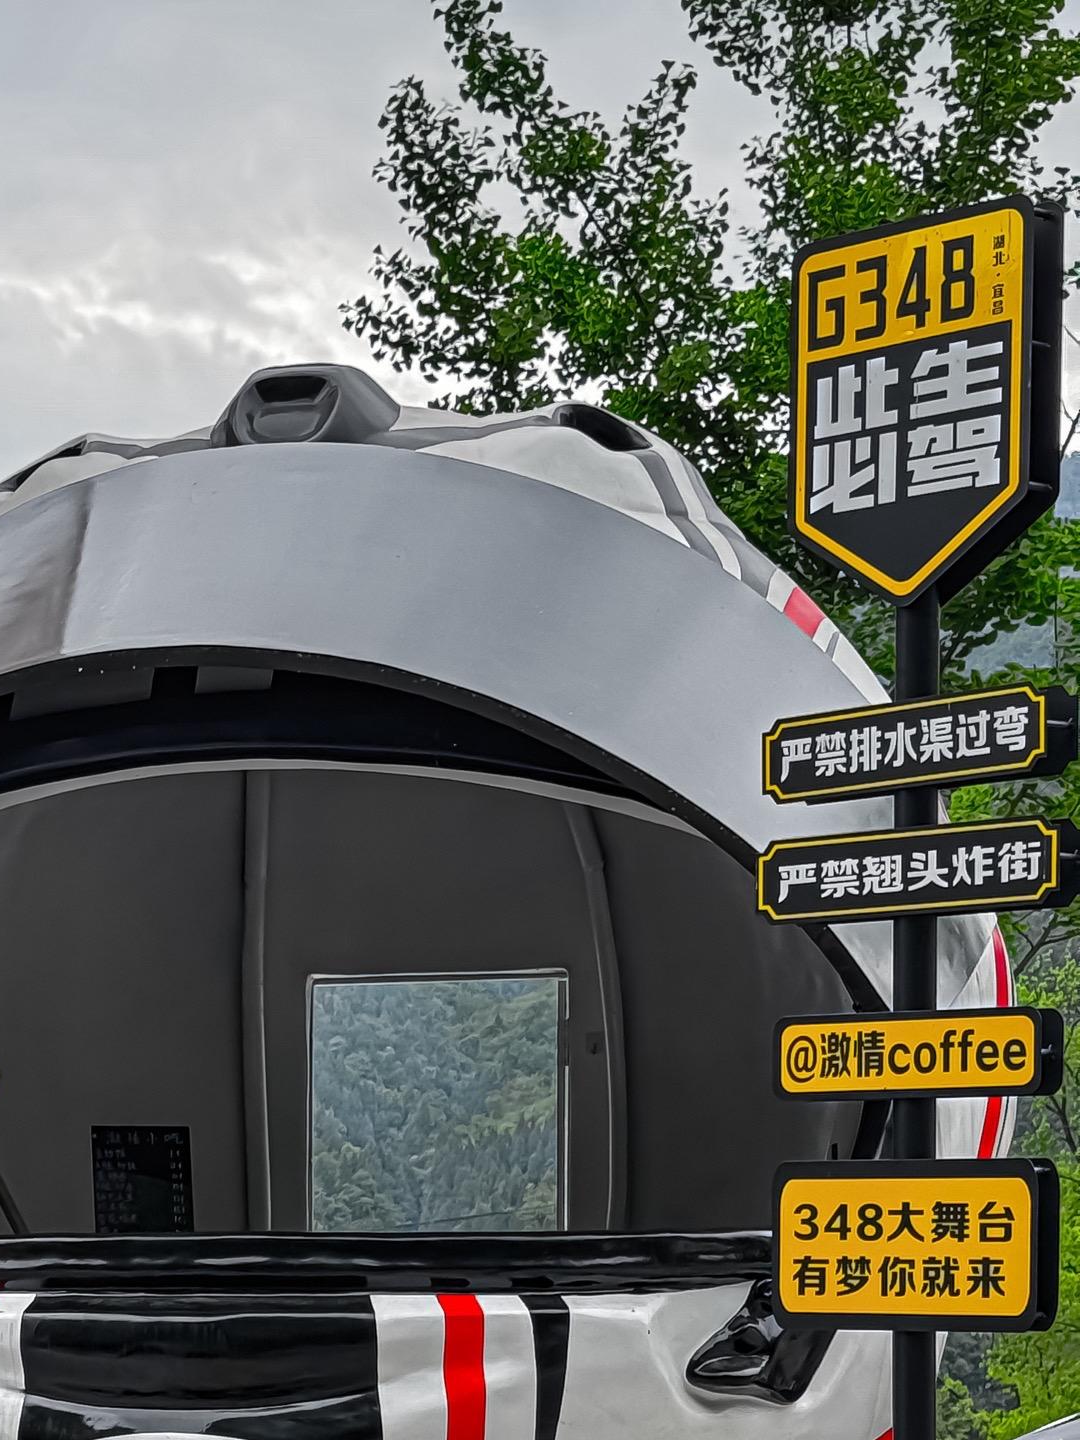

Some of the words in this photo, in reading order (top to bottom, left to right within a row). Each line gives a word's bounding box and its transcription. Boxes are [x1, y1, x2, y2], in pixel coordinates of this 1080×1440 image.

[807, 235, 975, 352] G348
[814, 340, 1004, 440] 此生
[810, 414, 1001, 515] 必驾
[780, 705, 1030, 784] 严禁排水渠过弯
[778, 841, 1041, 904] 严禁翘头炸街
[786, 1029, 1027, 1084] @激情coffee
[793, 1201, 1016, 1244] 348大舞台
[792, 1255, 1006, 1299] 有梦你就来
